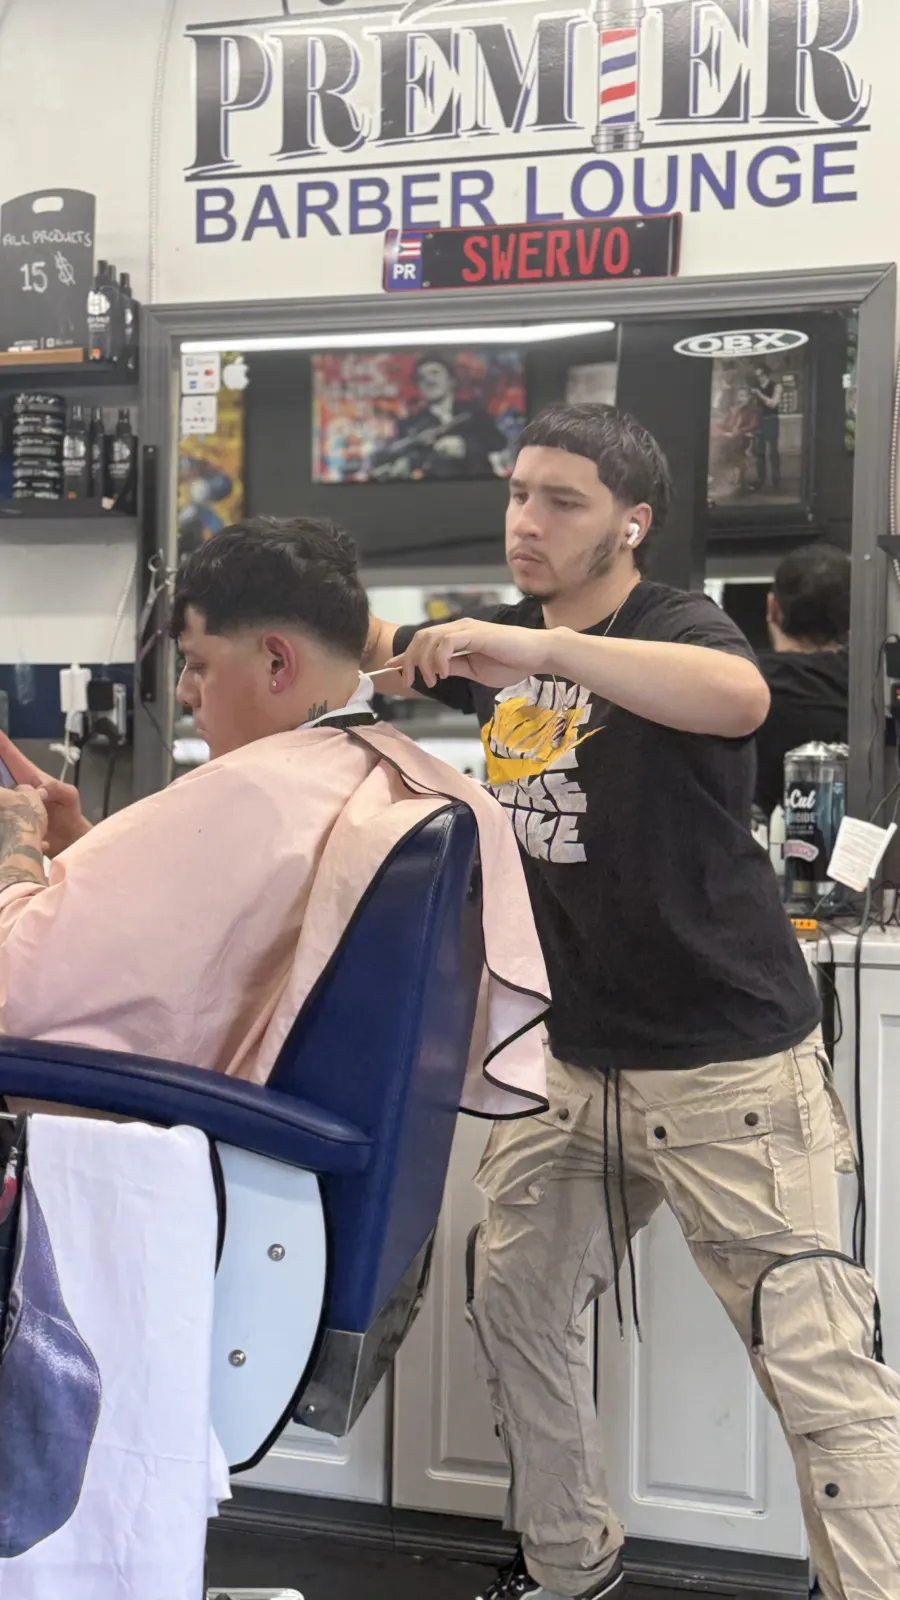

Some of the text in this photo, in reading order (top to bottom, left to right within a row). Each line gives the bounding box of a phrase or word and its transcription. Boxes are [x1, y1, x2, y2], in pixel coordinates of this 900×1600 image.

[196, 142, 858, 243] BARBER LOUNGE
[2, 229, 92, 247] ALL PRODUCTS
[462, 227, 628, 283] SWERVO
[19, 260, 48, 293] 15
[393, 263, 416, 280] PR
[688, 332, 787, 353] OBX
